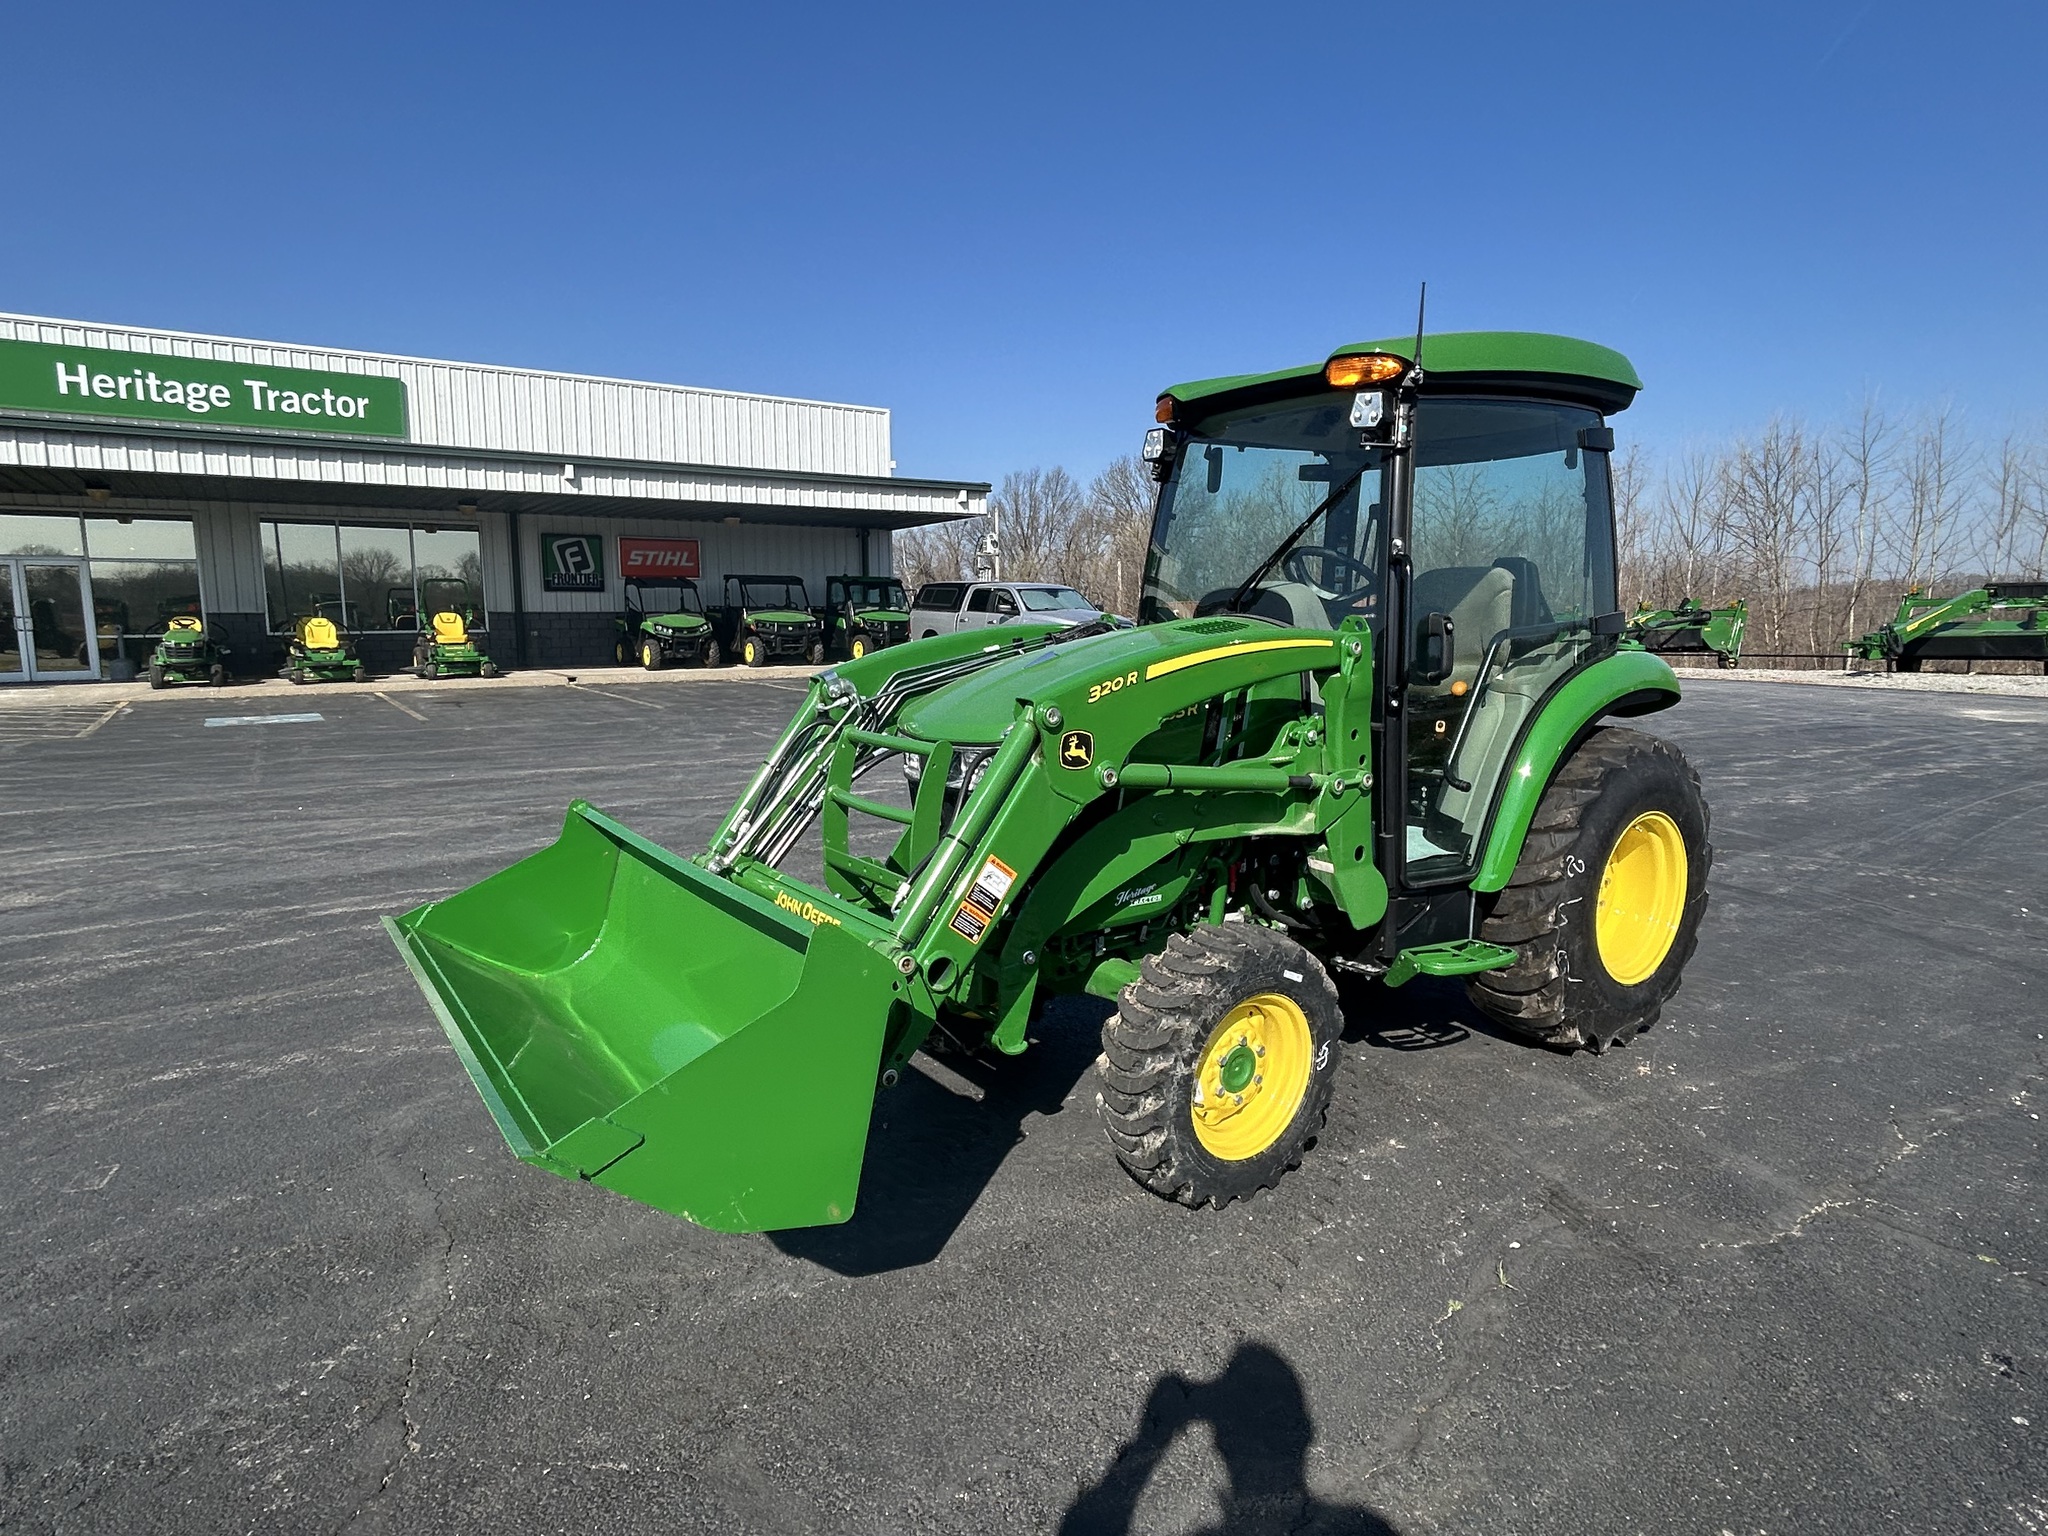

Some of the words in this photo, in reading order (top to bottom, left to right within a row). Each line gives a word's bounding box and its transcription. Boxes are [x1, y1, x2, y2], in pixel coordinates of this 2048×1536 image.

[56, 361, 231, 413] Heritage
[243, 379, 369, 419] Tractor
[627, 550, 695, 567] STIHL
[552, 572, 599, 586] FRONTIER
[774, 889, 803, 916] JOHN
[1114, 883, 1157, 907] Heritage
